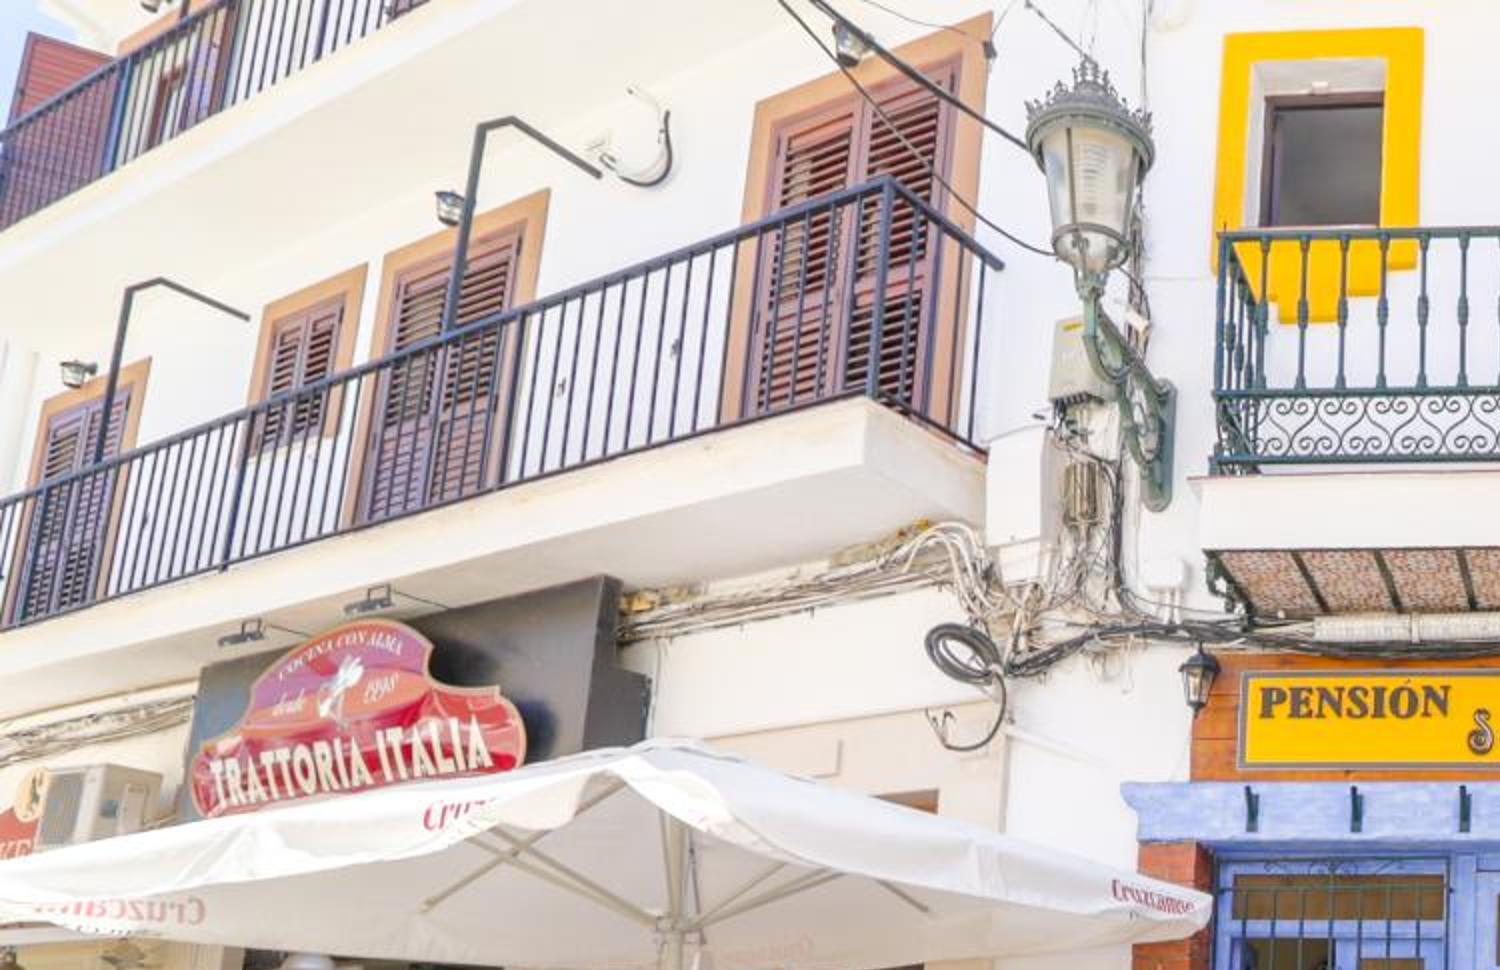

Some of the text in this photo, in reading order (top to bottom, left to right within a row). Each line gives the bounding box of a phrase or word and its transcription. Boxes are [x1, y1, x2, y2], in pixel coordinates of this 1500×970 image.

[1258, 678, 1452, 720] PENSIÓN
[209, 714, 494, 807] TRATTORIA ITALIA
